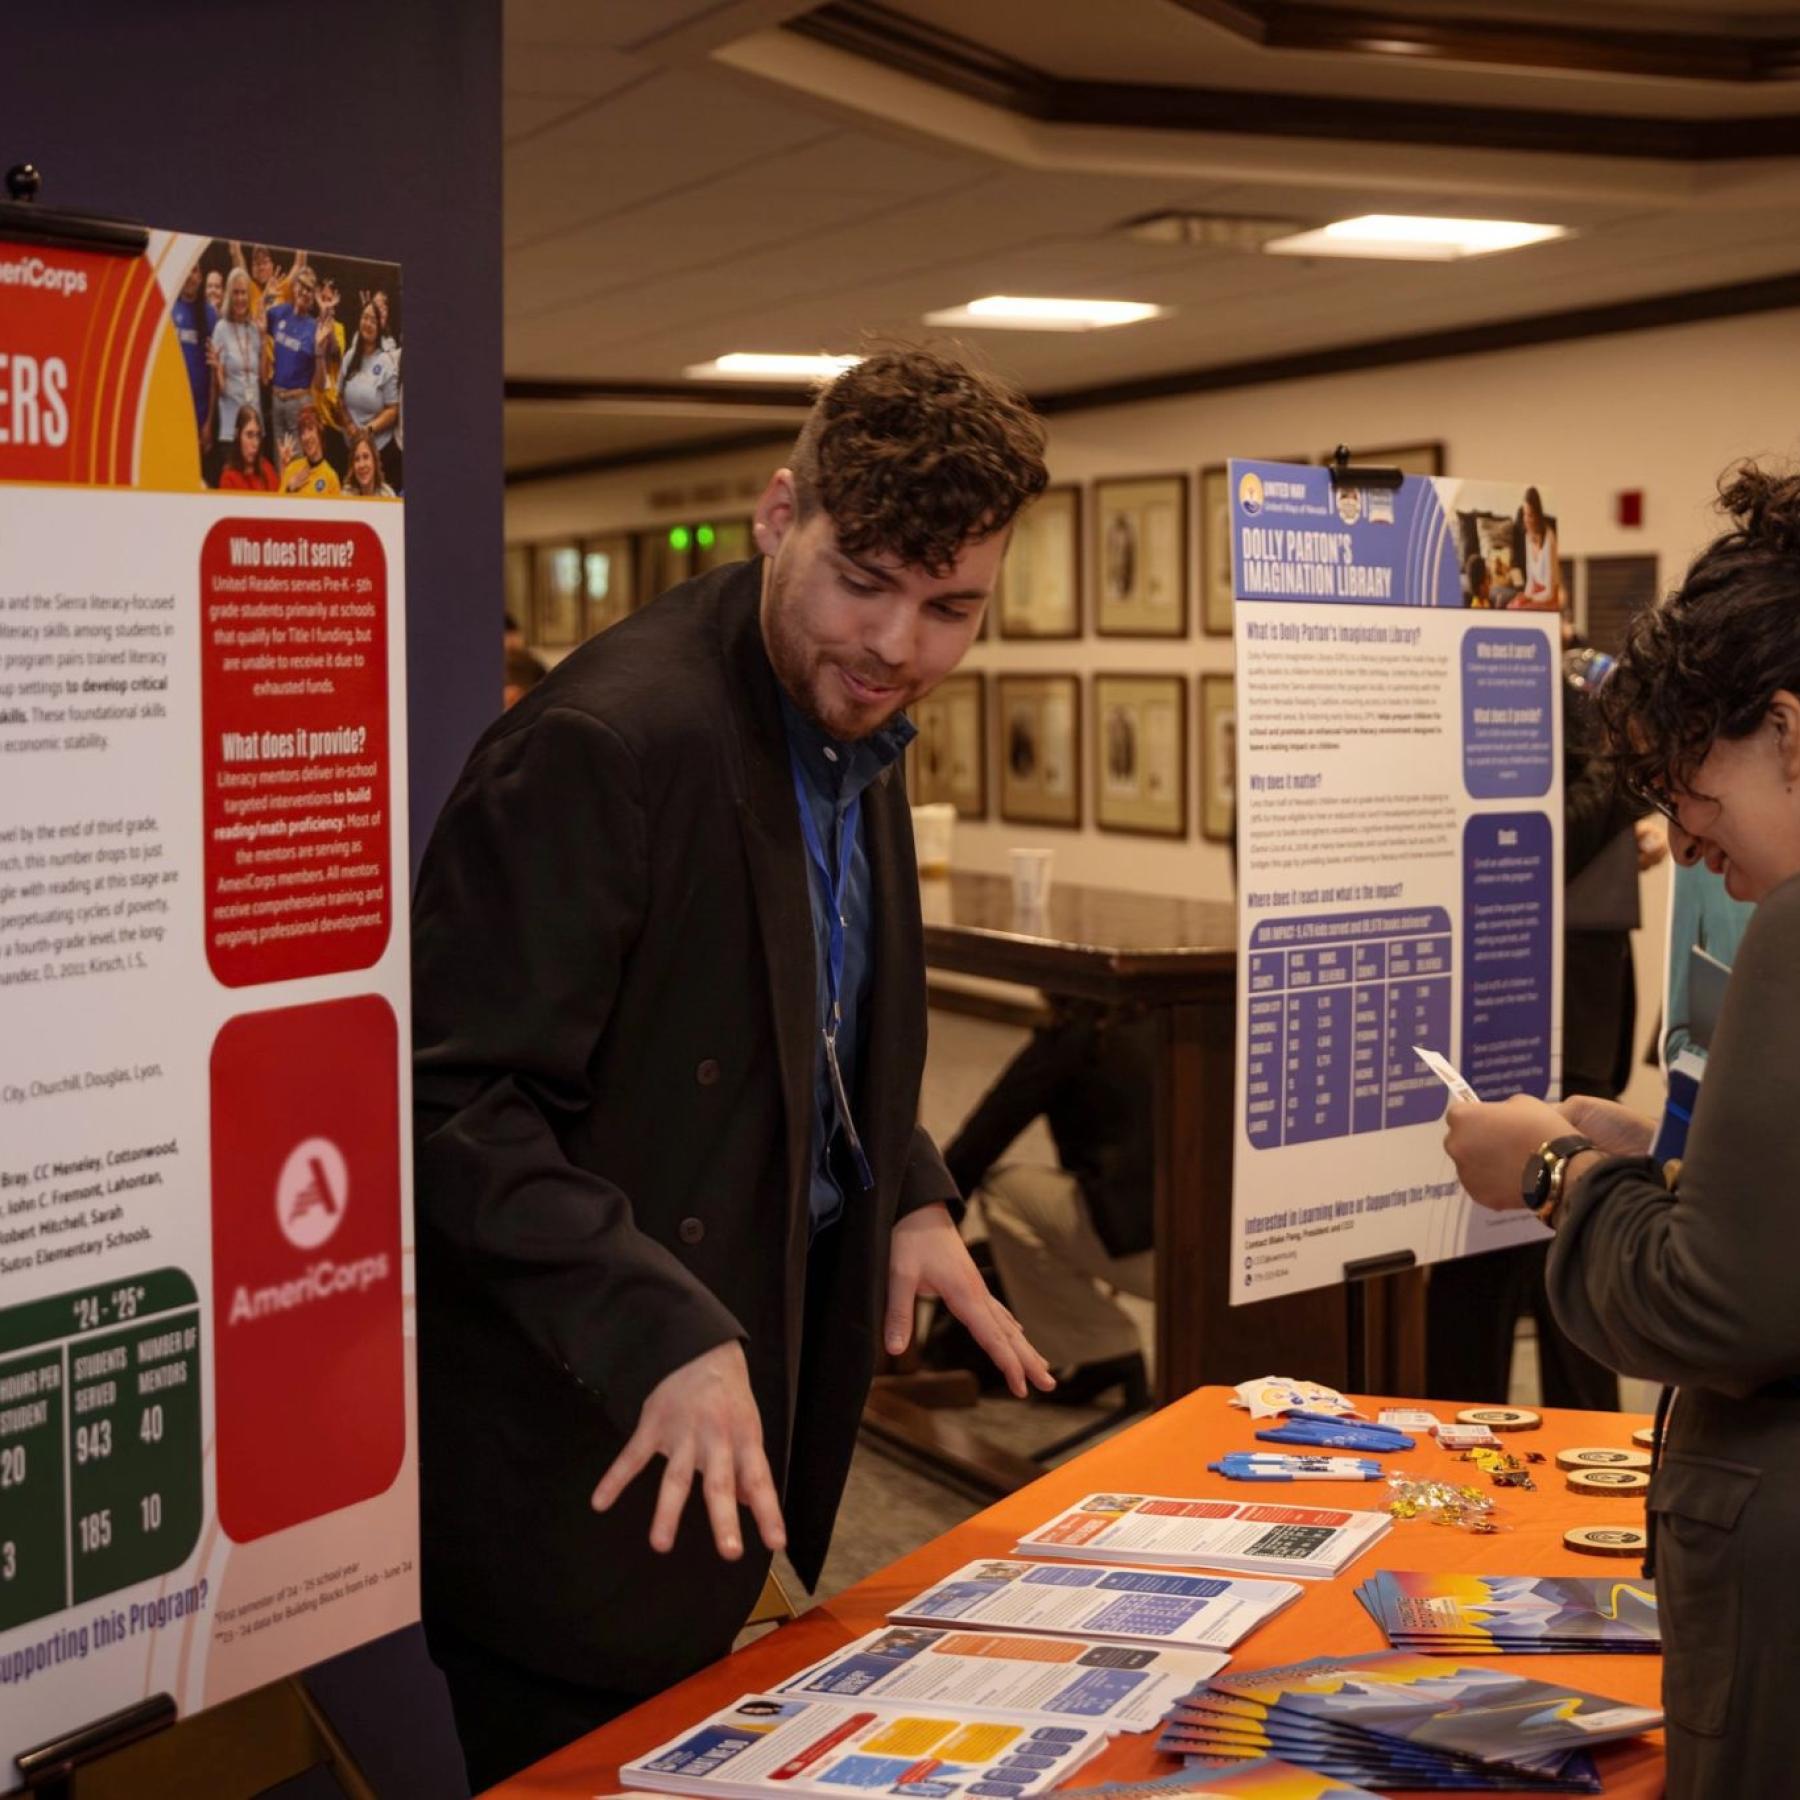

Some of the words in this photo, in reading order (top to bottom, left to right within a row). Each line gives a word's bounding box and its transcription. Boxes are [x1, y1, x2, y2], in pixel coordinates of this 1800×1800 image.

[230, 538, 260, 566] Who
[263, 539, 296, 566] does
[298, 538, 309, 567] it
[310, 541, 354, 567] serve?
[1242, 527, 1284, 560] DOLLY
[1286, 530, 1352, 564] PARTON'S
[1244, 560, 1334, 595] IMAGINATION
[1337, 565, 1392, 598] LIBRARY
[340, 602, 376, 617] schools
[82, 678, 128, 694] develop
[131, 675, 168, 692] critical
[222, 732, 259, 761] What
[261, 731, 294, 759] does
[296, 728, 308, 758] it
[309, 726, 366, 760] provide?
[346, 787, 371, 803] build
[36, 1240, 103, 1266] Elementary
[229, 1253, 388, 1326] AmeriCorps
[74, 1346, 128, 1382] STUDENTS
[137, 1331, 179, 1364] NUMBER
[180, 1326, 198, 1352] OF
[138, 1361, 188, 1395] MENTORS
[76, 1419, 112, 1465] 943
[140, 1404, 164, 1442] 40
[79, 1509, 112, 1553] 185
[140, 1493, 162, 1532] 10
[0, 1627, 88, 1684] upporting
[93, 1610, 126, 1649] this
[129, 1578, 209, 1636] Program?
